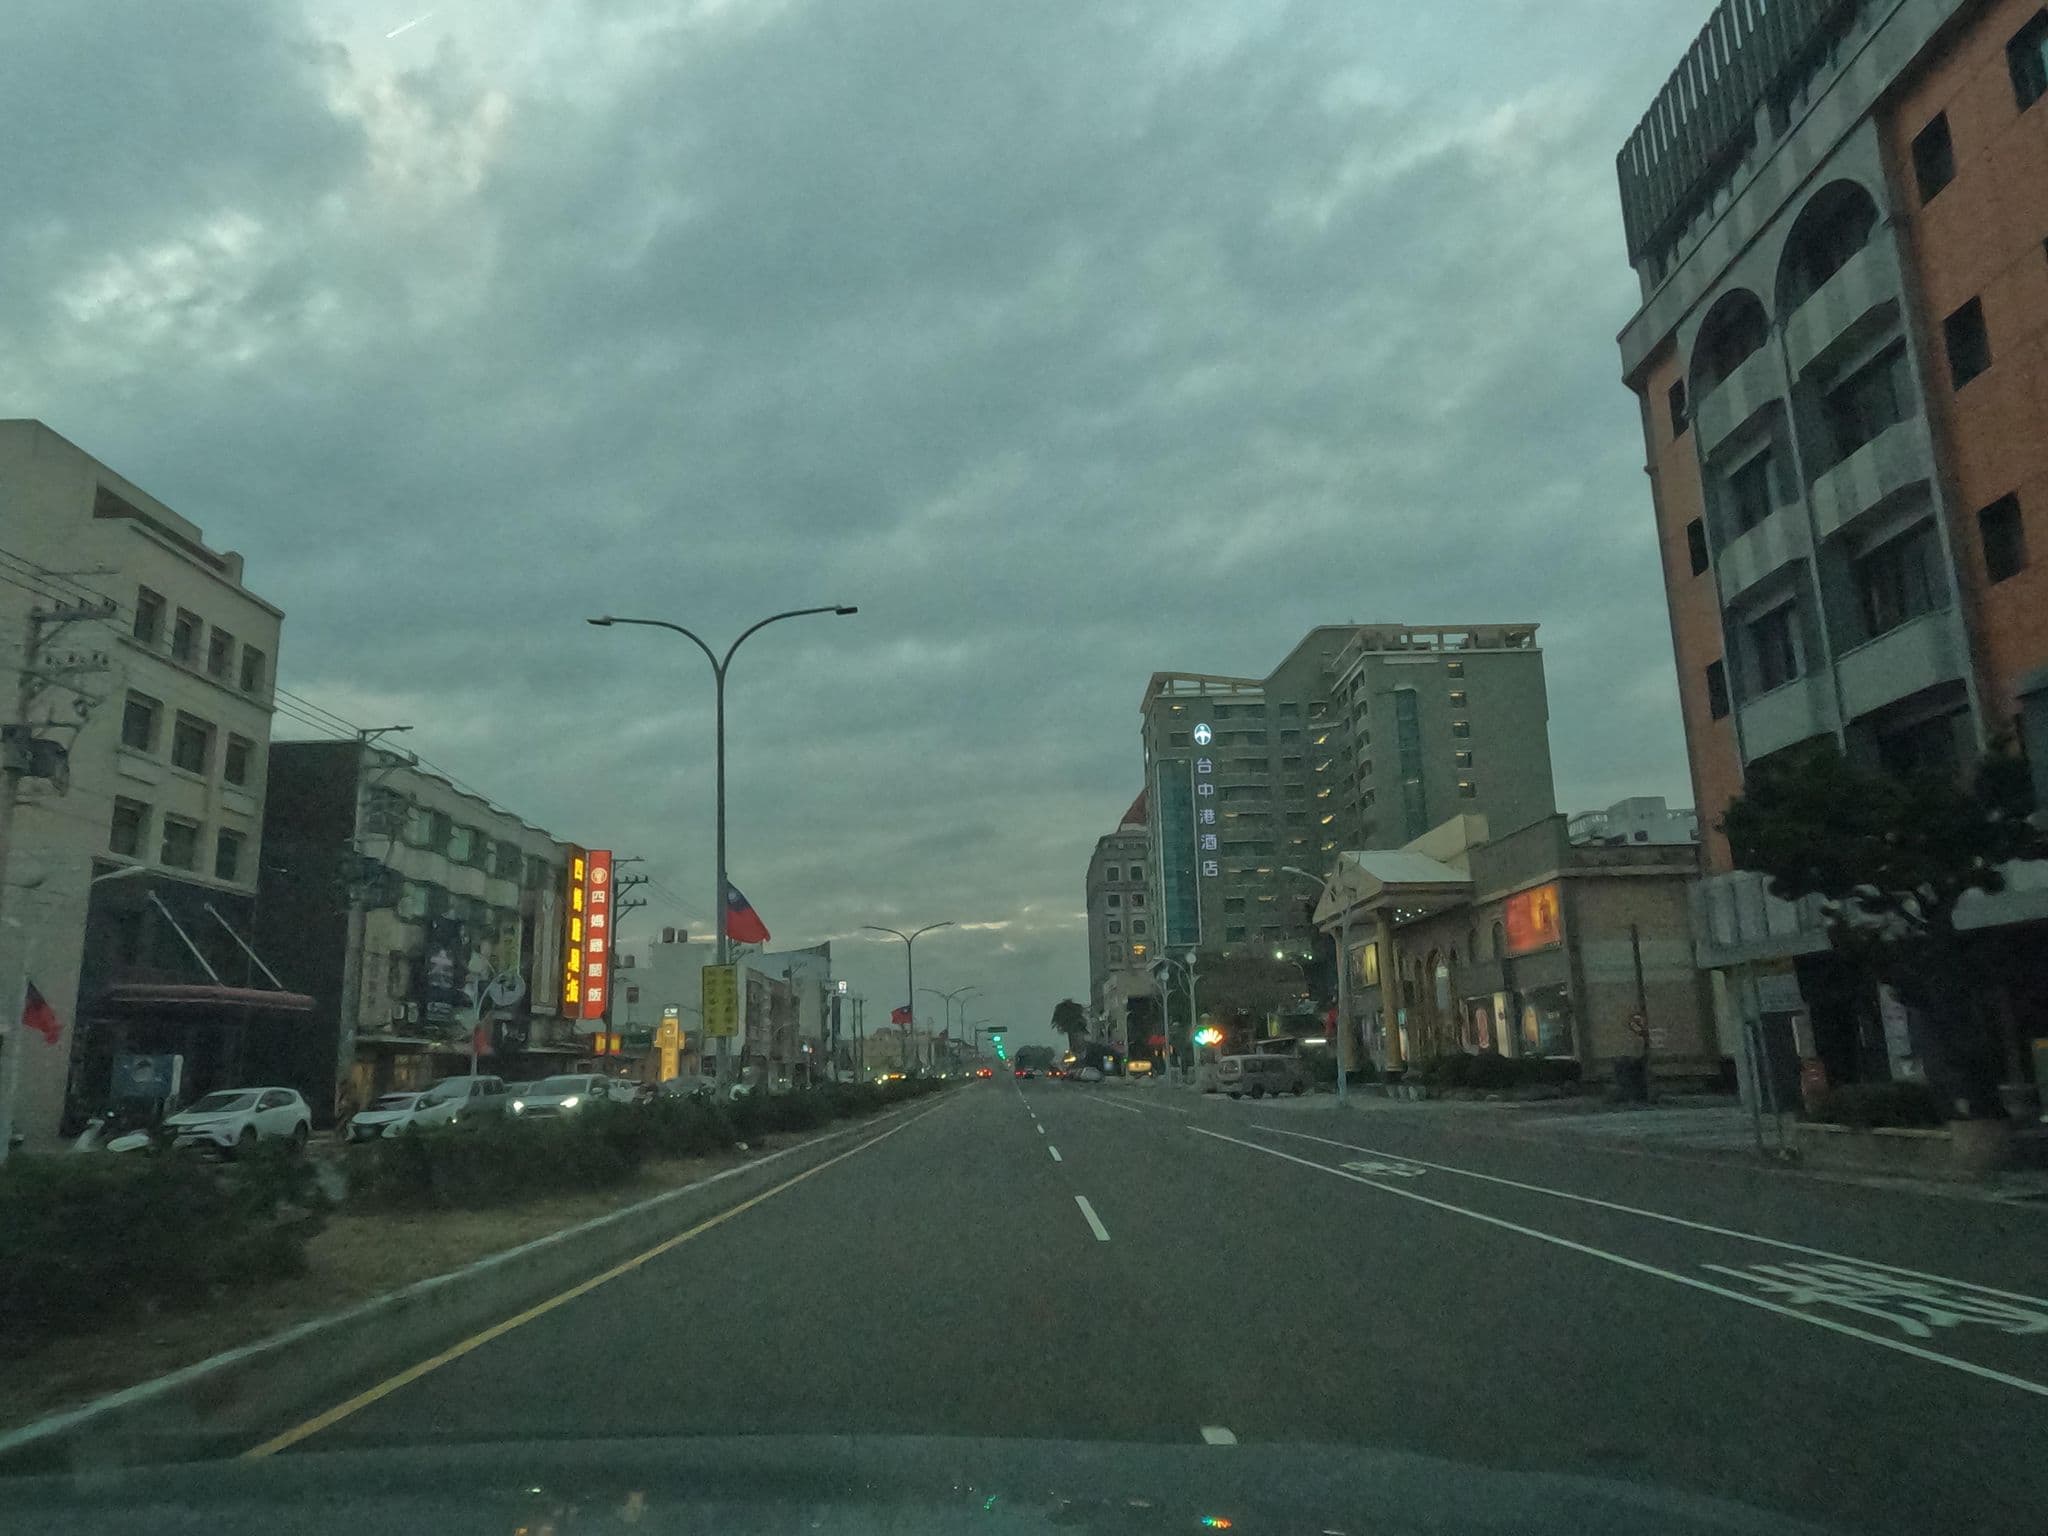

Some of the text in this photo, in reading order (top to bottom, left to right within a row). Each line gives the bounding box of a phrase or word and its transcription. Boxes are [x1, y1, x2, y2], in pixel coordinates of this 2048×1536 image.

[1196, 757, 1219, 878] 台中港酒店
